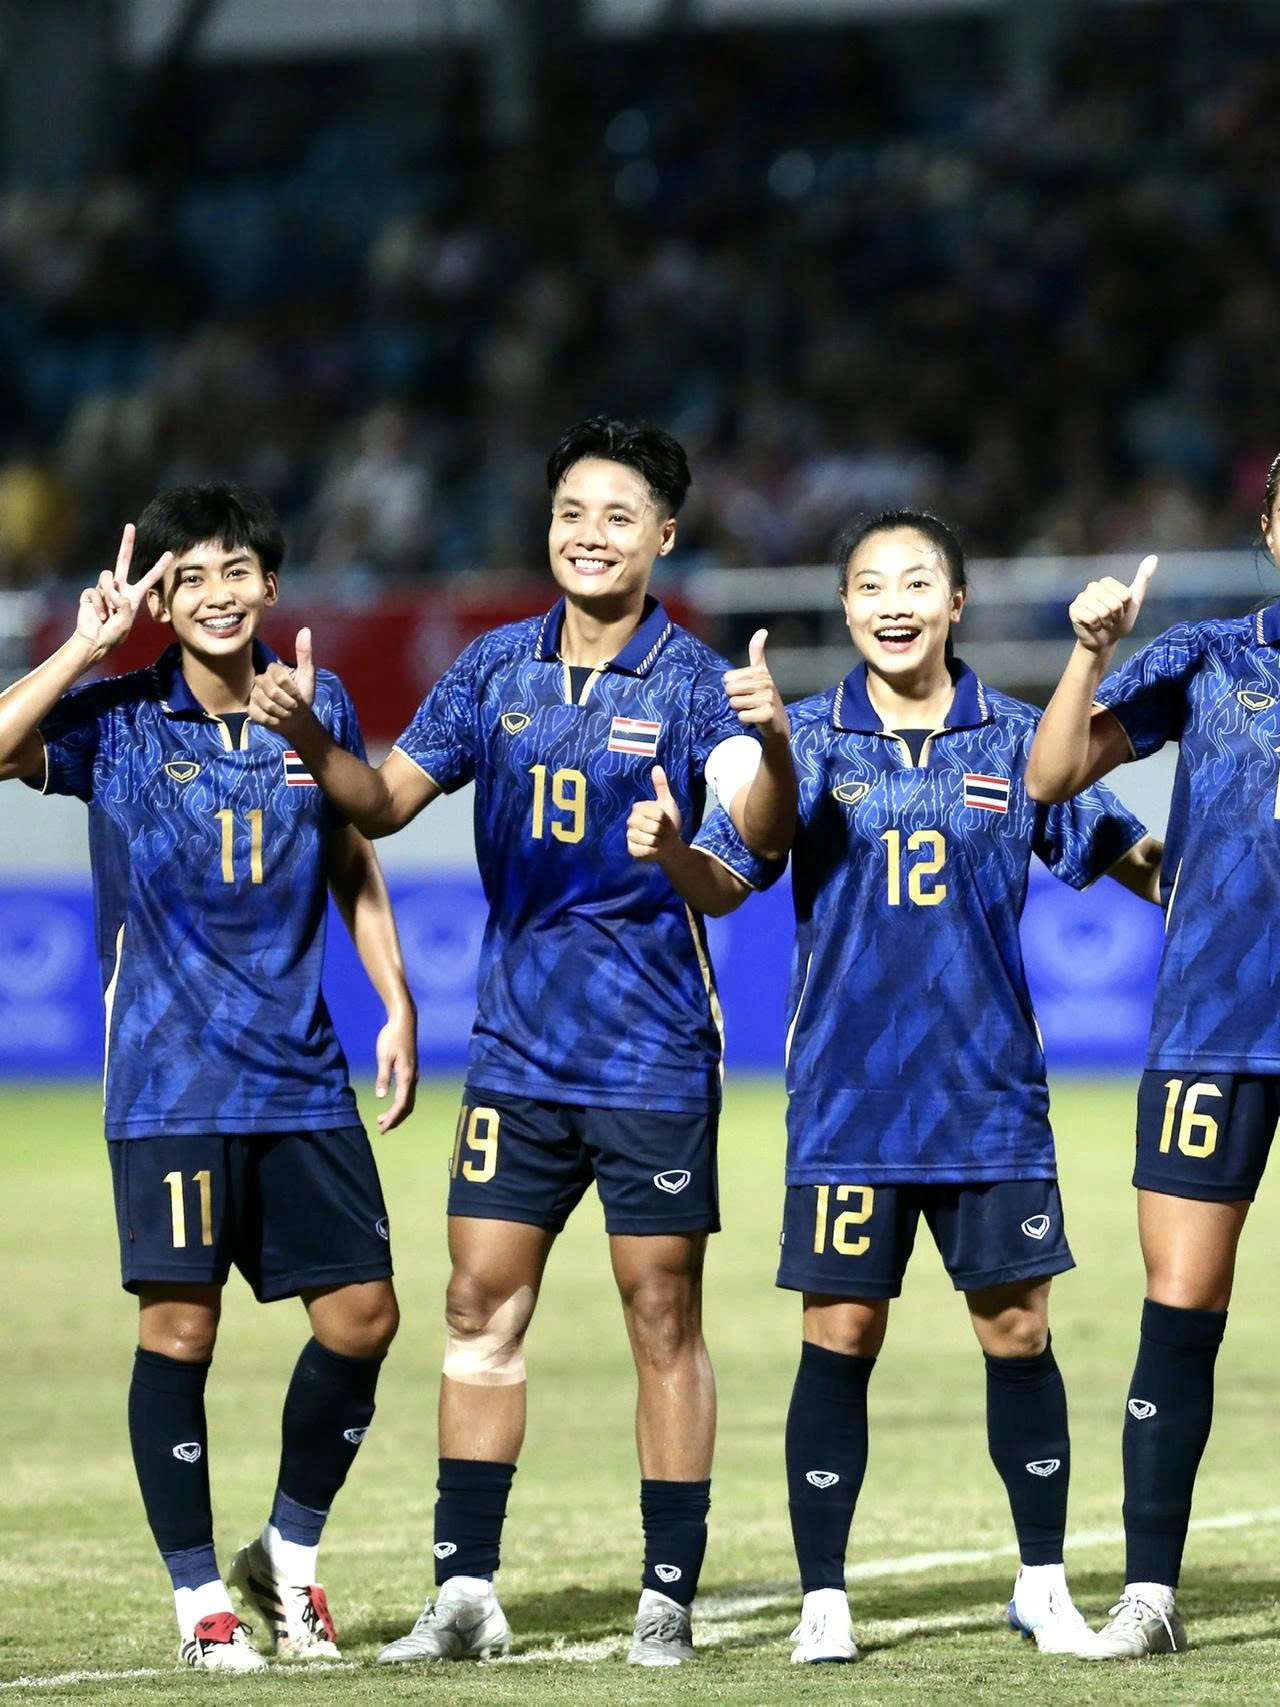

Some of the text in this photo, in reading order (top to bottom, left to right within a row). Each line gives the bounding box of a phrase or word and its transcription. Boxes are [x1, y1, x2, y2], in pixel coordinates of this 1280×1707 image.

[528, 764, 587, 844] 19
[214, 809, 263, 884] 11
[879, 830, 947, 906] 12
[452, 1104, 500, 1183] 19
[1159, 1078, 1222, 1159] 16
[163, 1171, 212, 1248] 11
[813, 1184, 874, 1256] 12
